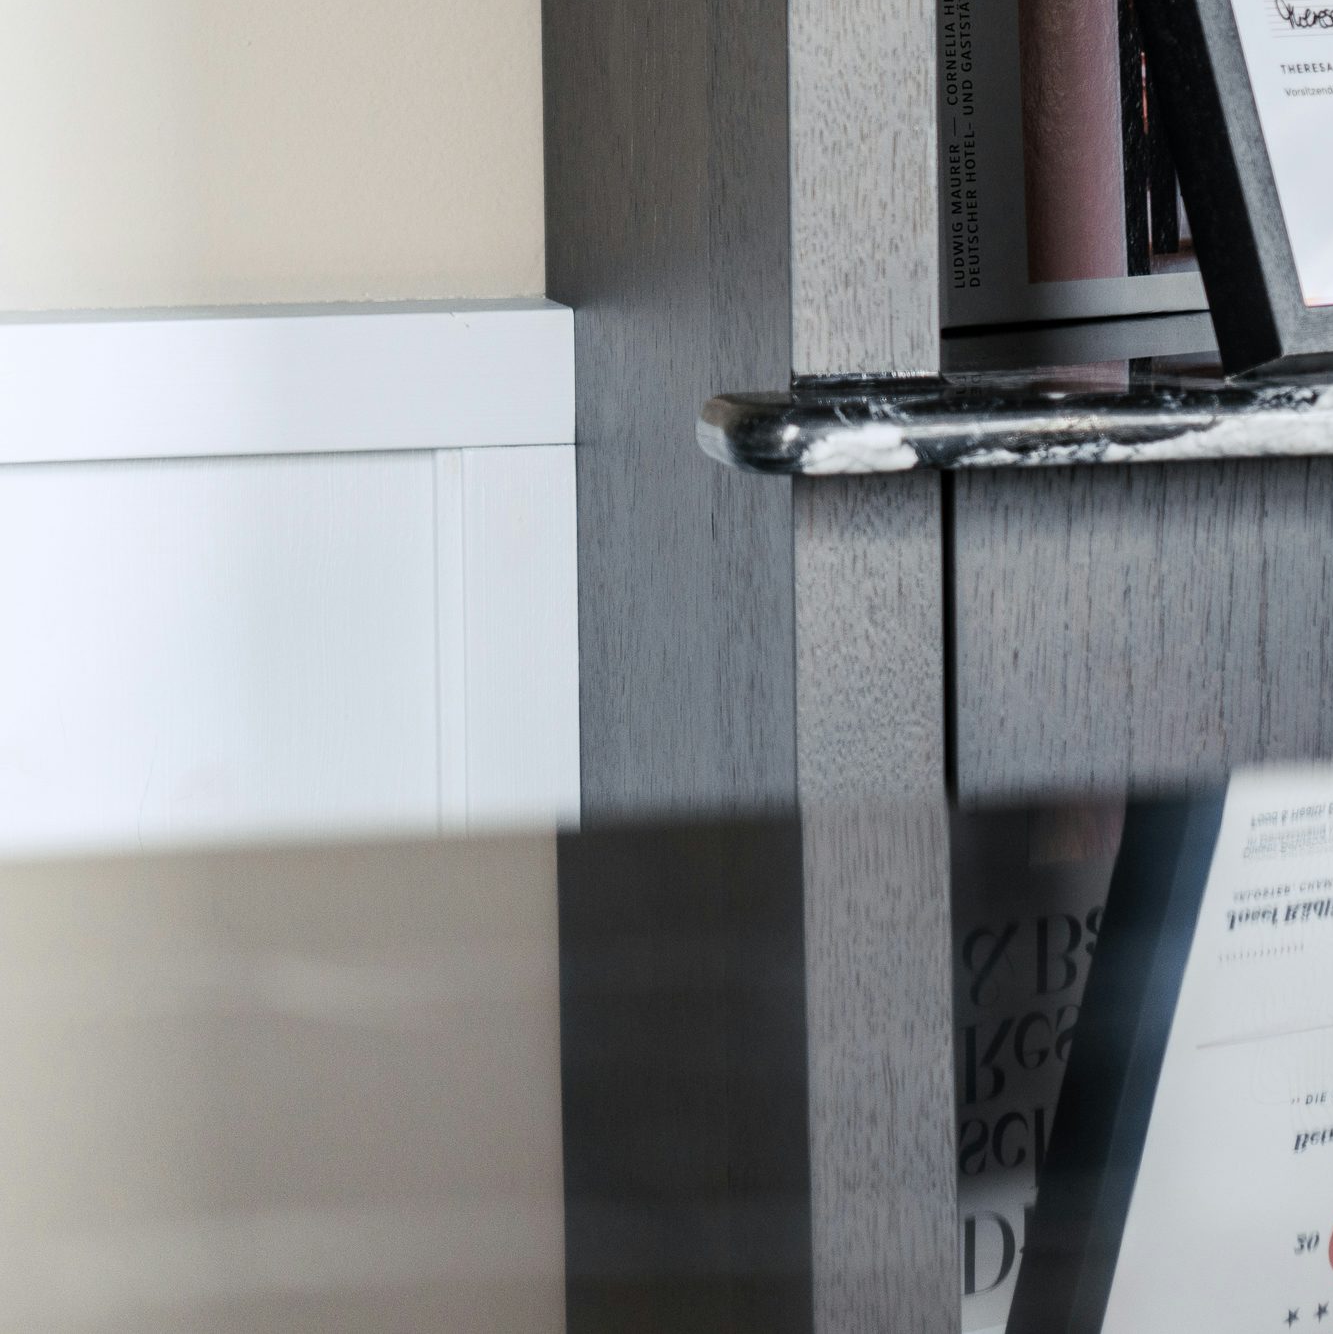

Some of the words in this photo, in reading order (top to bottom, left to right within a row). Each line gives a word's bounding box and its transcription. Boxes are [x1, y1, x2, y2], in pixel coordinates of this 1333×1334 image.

[945, 23, 958, 106] CORNELIA
[961, 79, 974, 115] UND
[1281, 64, 1332, 74] THERESA
[949, 144, 962, 215] MAURER
[963, 122, 977, 182] HOTEL-
[952, 221, 965, 289] LUDWIG
[966, 189, 981, 287] DEUTSCHER
